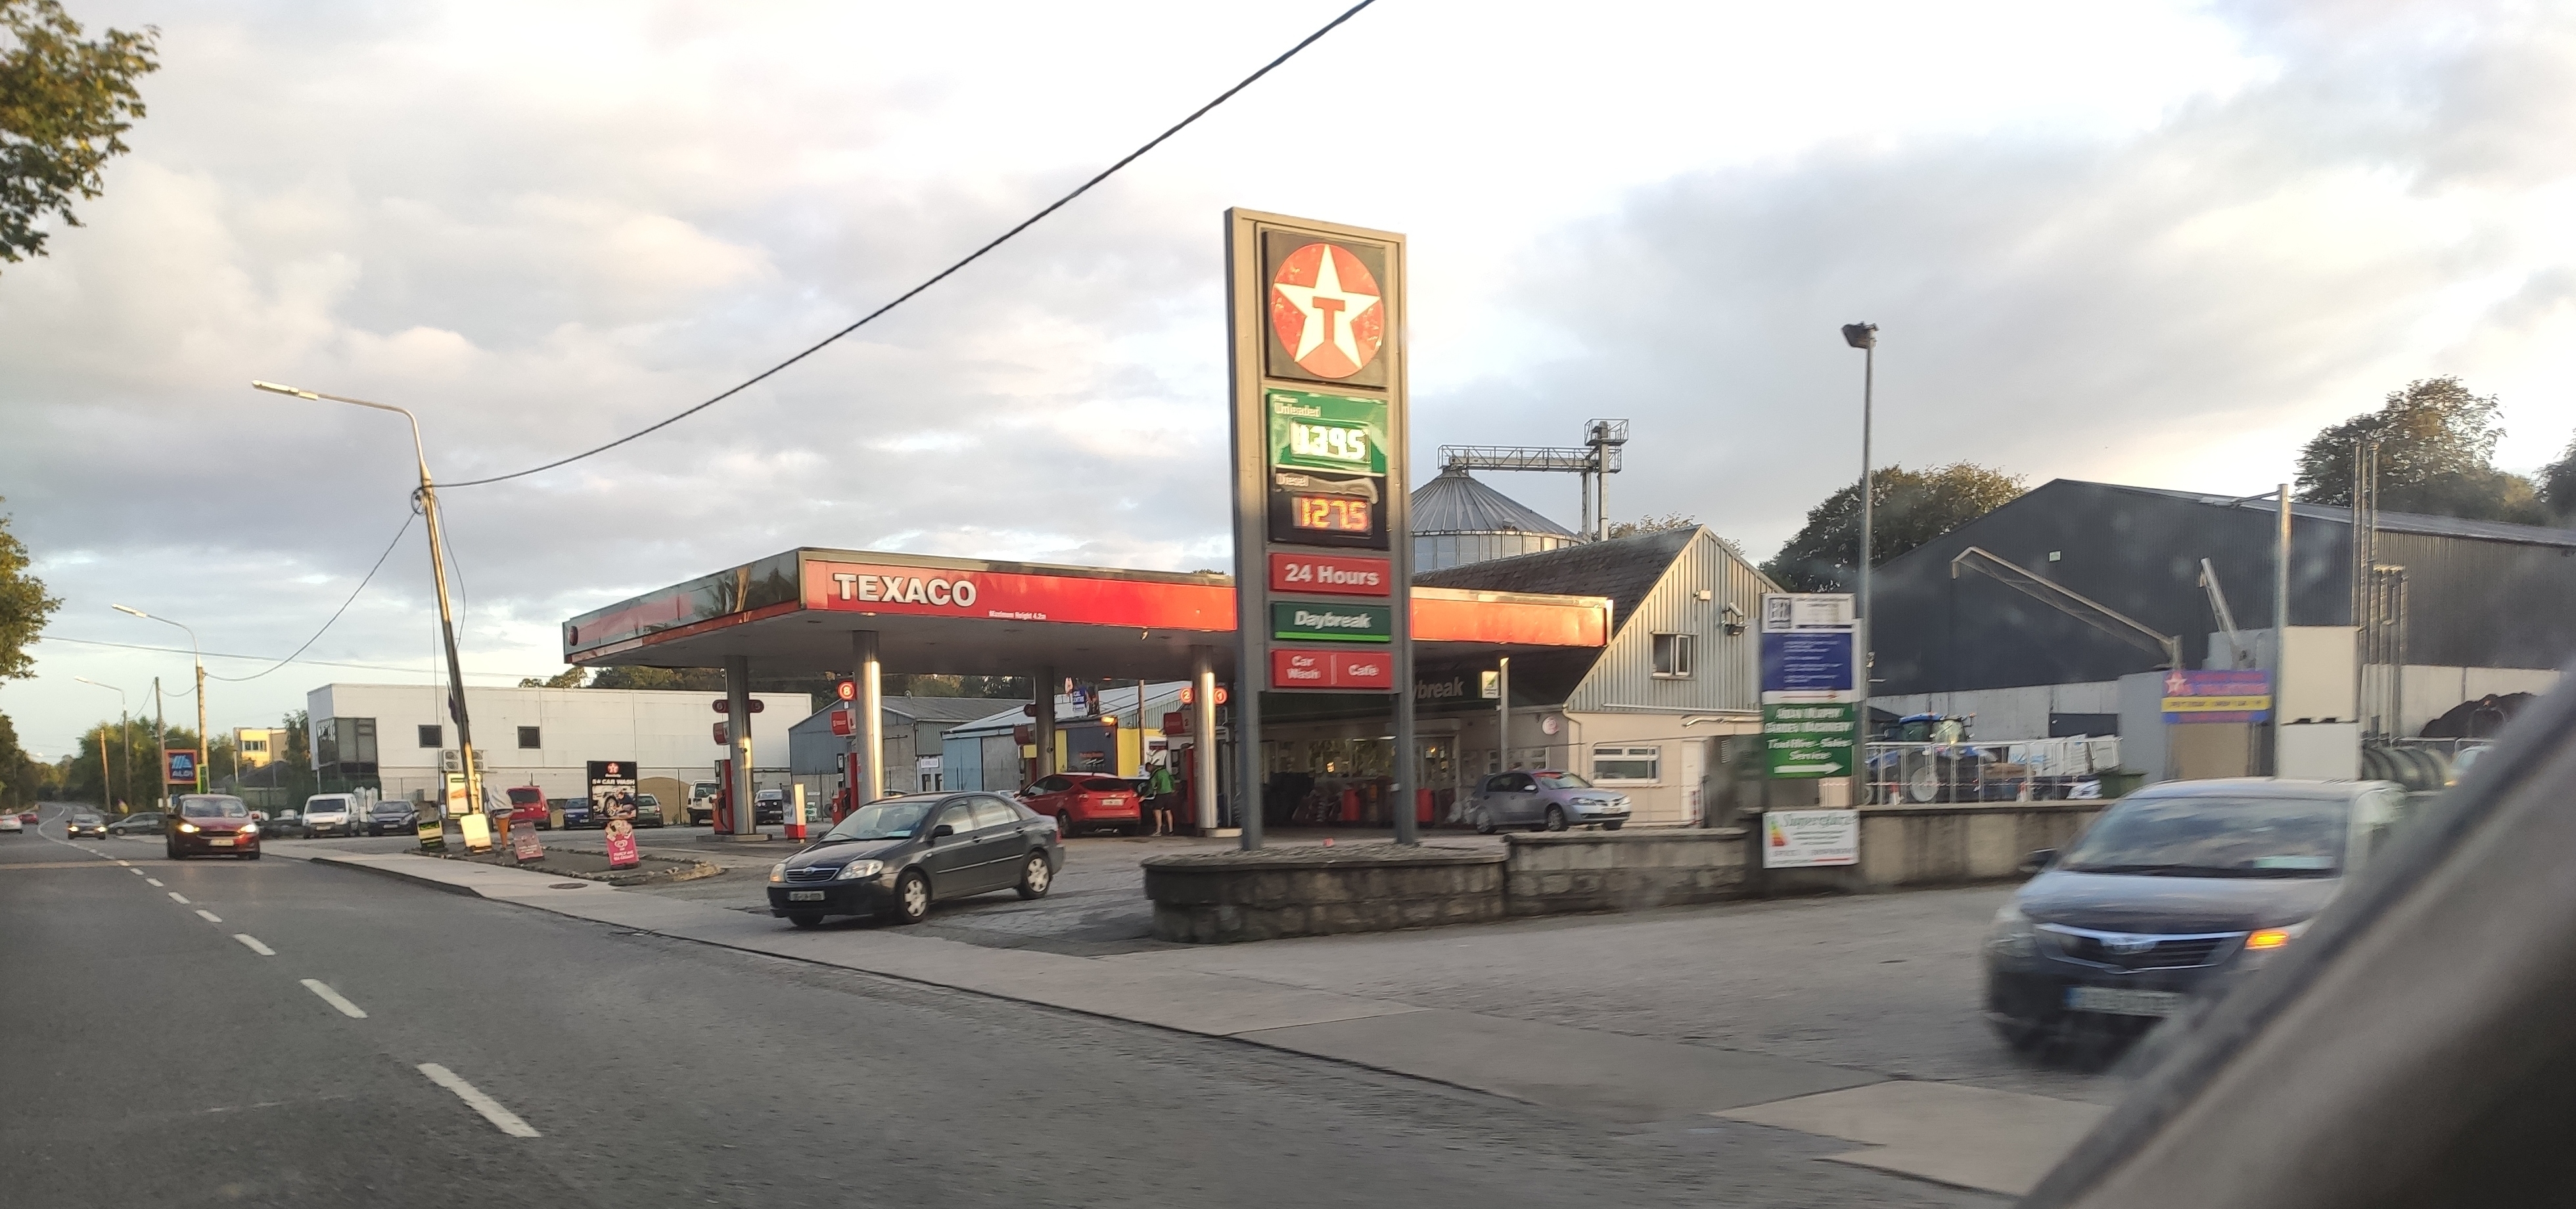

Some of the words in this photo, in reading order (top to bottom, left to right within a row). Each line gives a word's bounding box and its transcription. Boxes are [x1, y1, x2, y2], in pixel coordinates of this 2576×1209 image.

[1312, 296, 1345, 342] T
[1275, 402, 1321, 417] Unleaded
[1276, 473, 1310, 487] Diesel
[1285, 563, 1312, 582] 24
[1318, 566, 1380, 586] Hours
[833, 573, 977, 607] TEXACO
[1294, 610, 1372, 629] Daybreak
[1292, 656, 1315, 666] Car
[1287, 668, 1322, 679] Wash
[843, 687, 851, 696] 8
[1412, 676, 1465, 698] break
[1184, 691, 1191, 699] 2
[1789, 750, 1832, 761] Service
